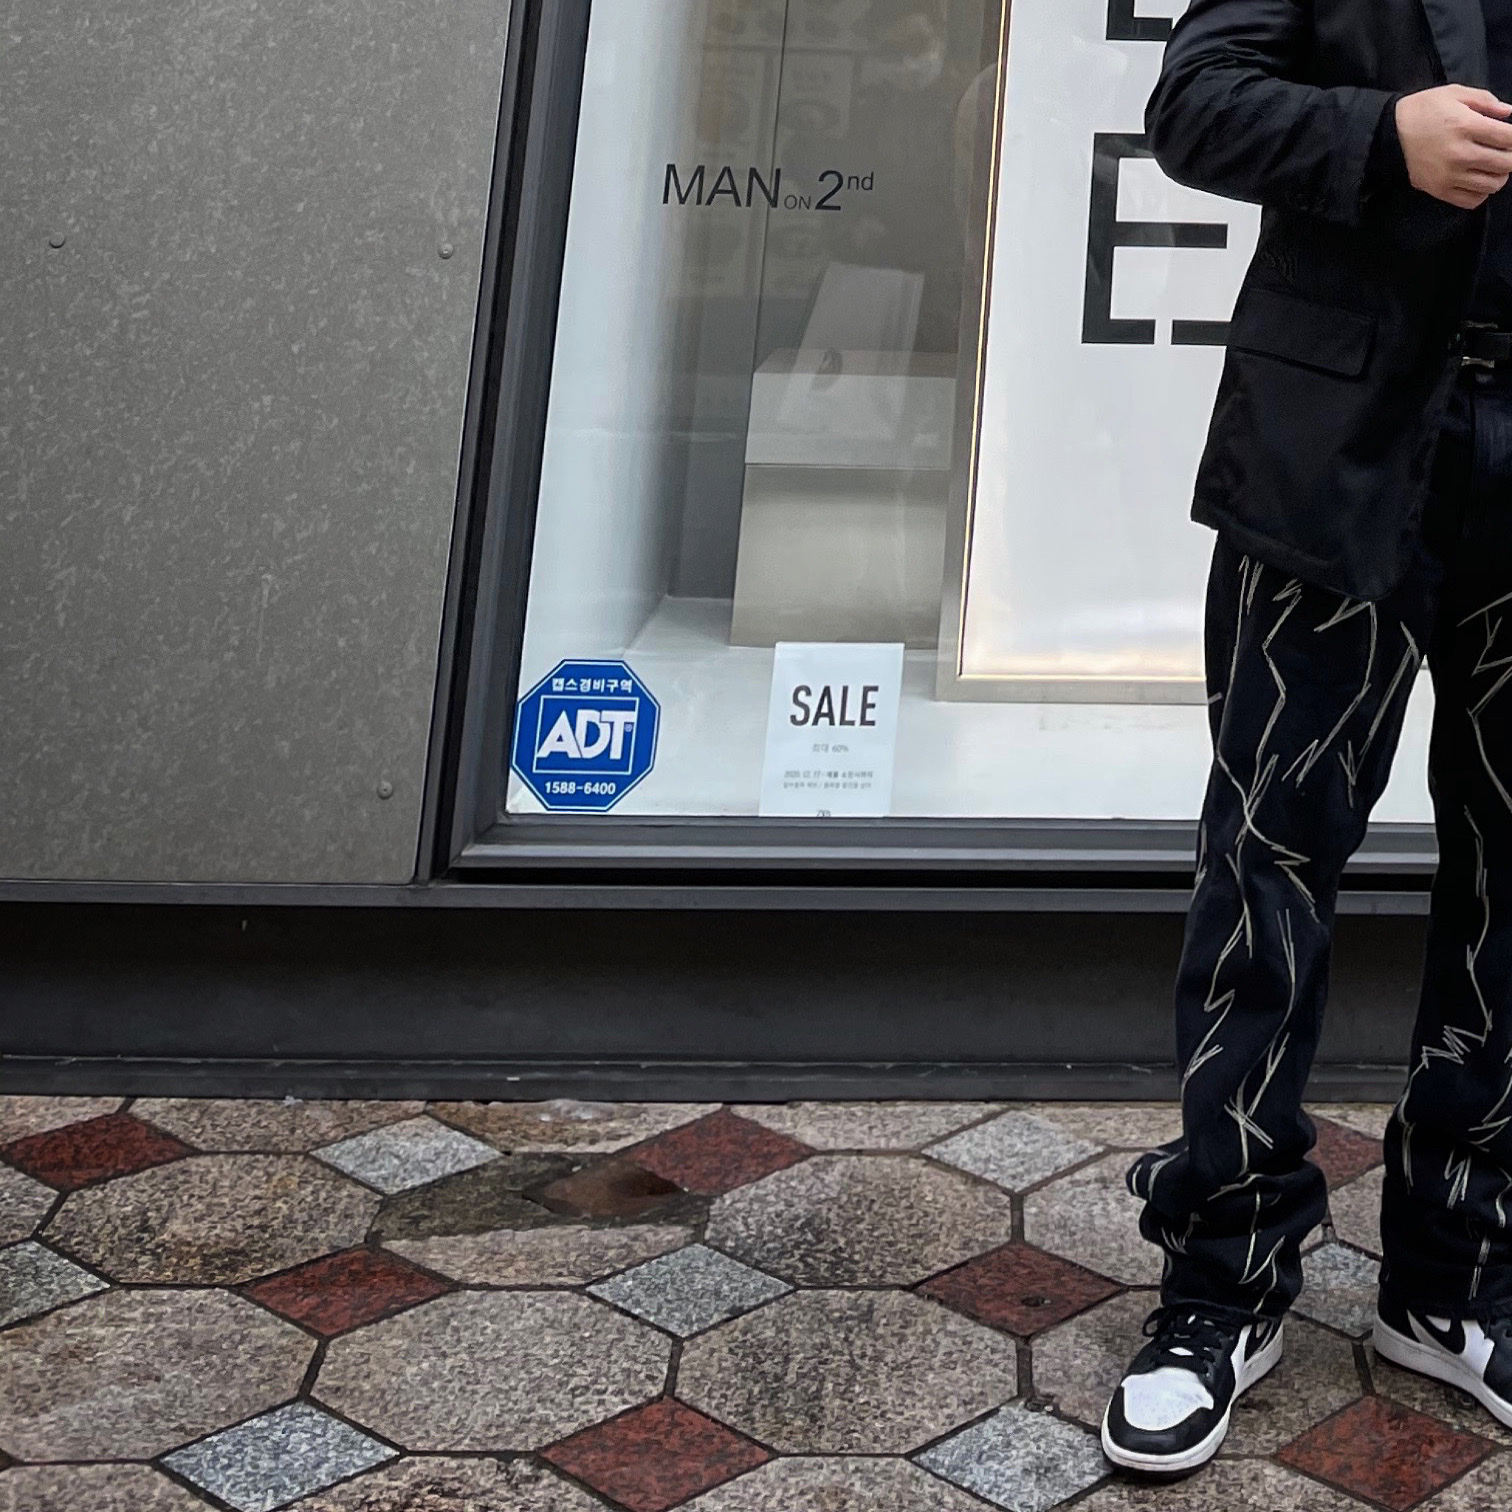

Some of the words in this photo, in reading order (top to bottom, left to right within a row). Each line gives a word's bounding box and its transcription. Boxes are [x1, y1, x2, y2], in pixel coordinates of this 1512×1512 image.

[662, 162, 782, 209] MAN
[783, 193, 812, 211] ON
[815, 169, 876, 211] 2nd
[789, 684, 880, 728] SALE
[536, 708, 637, 761] ADT
[544, 780, 617, 795] 1588-6400
